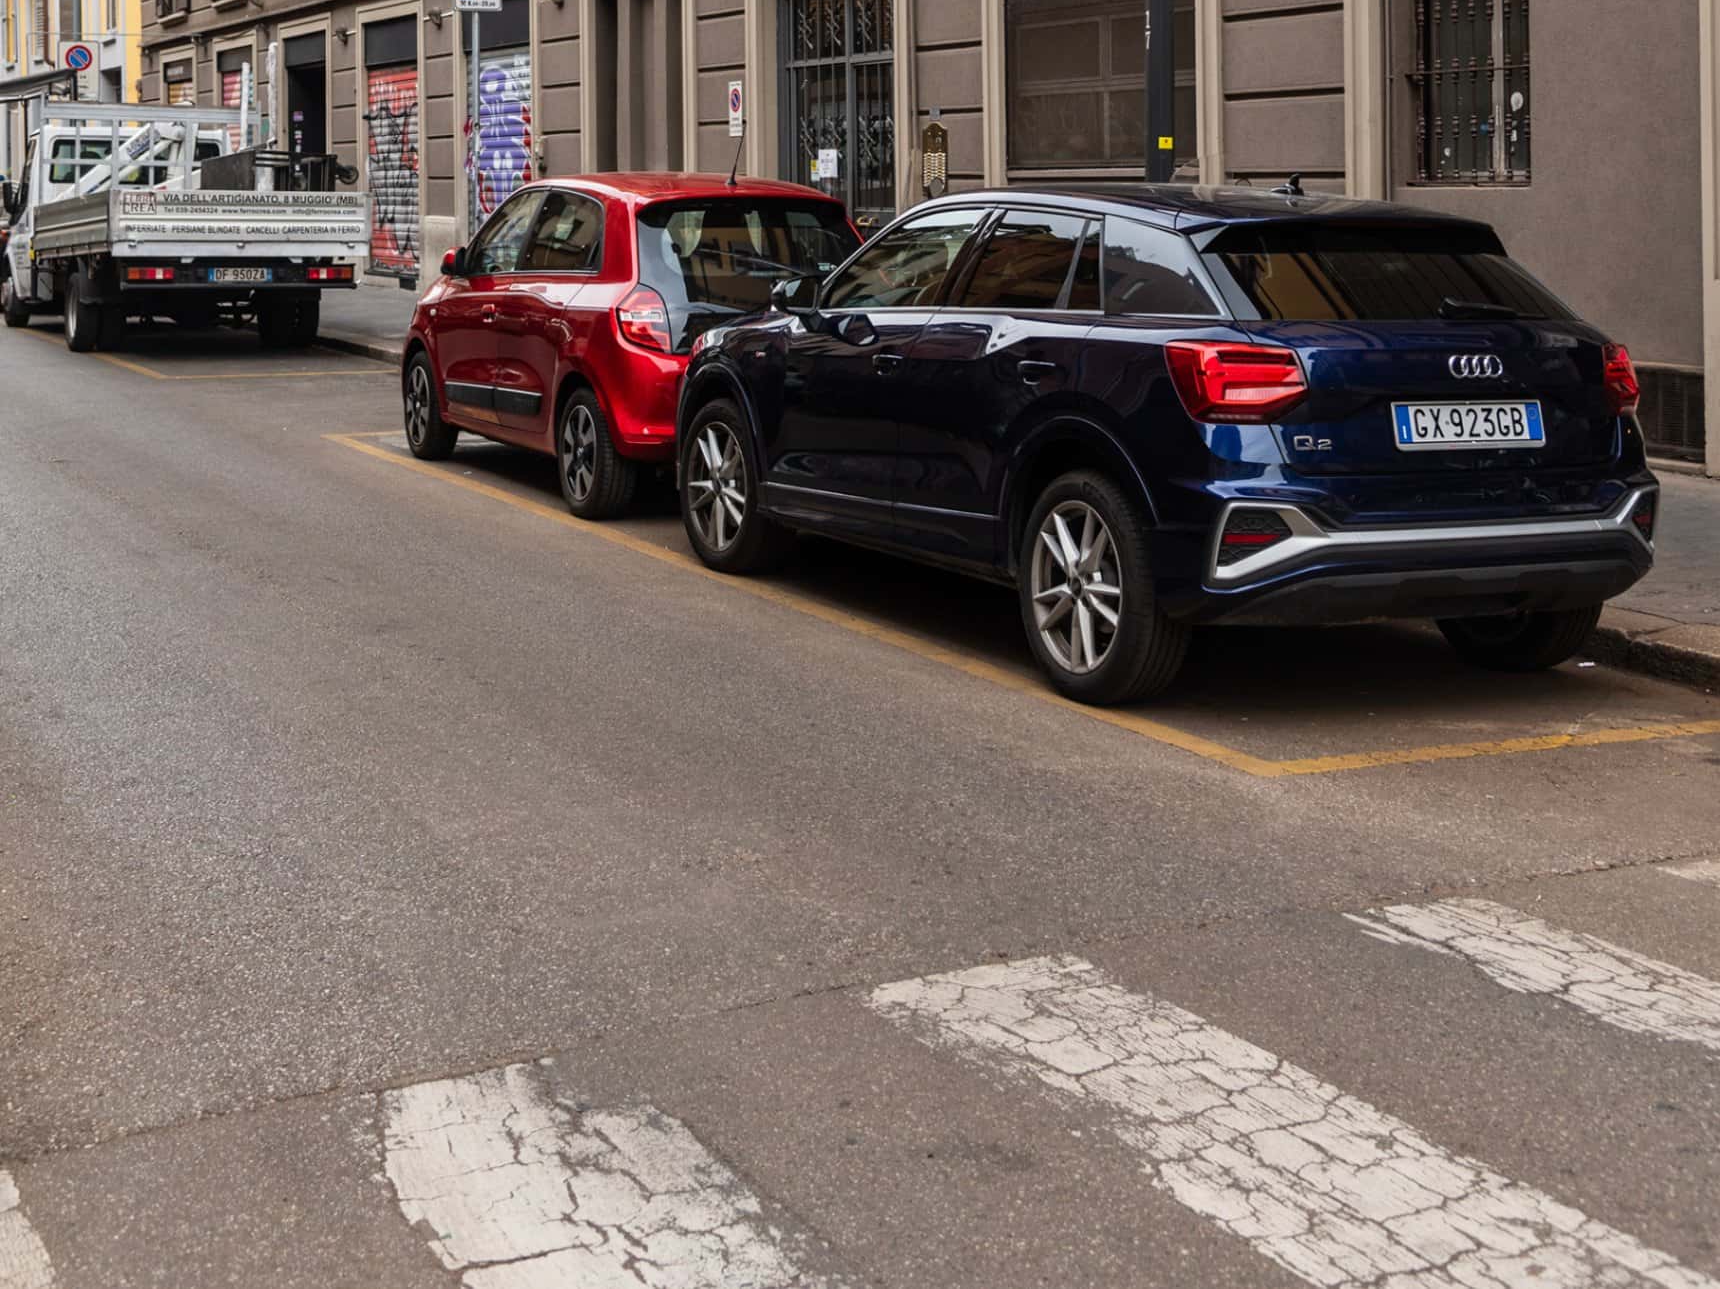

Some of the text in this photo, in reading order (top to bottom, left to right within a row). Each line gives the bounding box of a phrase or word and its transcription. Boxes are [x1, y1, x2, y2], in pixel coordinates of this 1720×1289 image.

[163, 194, 180, 203] VIA
[183, 194, 281, 205] DELL'ARTIGIANATO,
[336, 196, 358, 205] (MB)
[125, 224, 167, 233] INFERRIATE
[172, 225, 206, 233] PERSIANE
[208, 225, 241, 234] BLINDATE
[246, 226, 279, 234] CANCELLI
[281, 226, 329, 234] CARPENTERIA
[338, 225, 361, 234] FERRO
[1294, 435, 1333, 451] Q2
